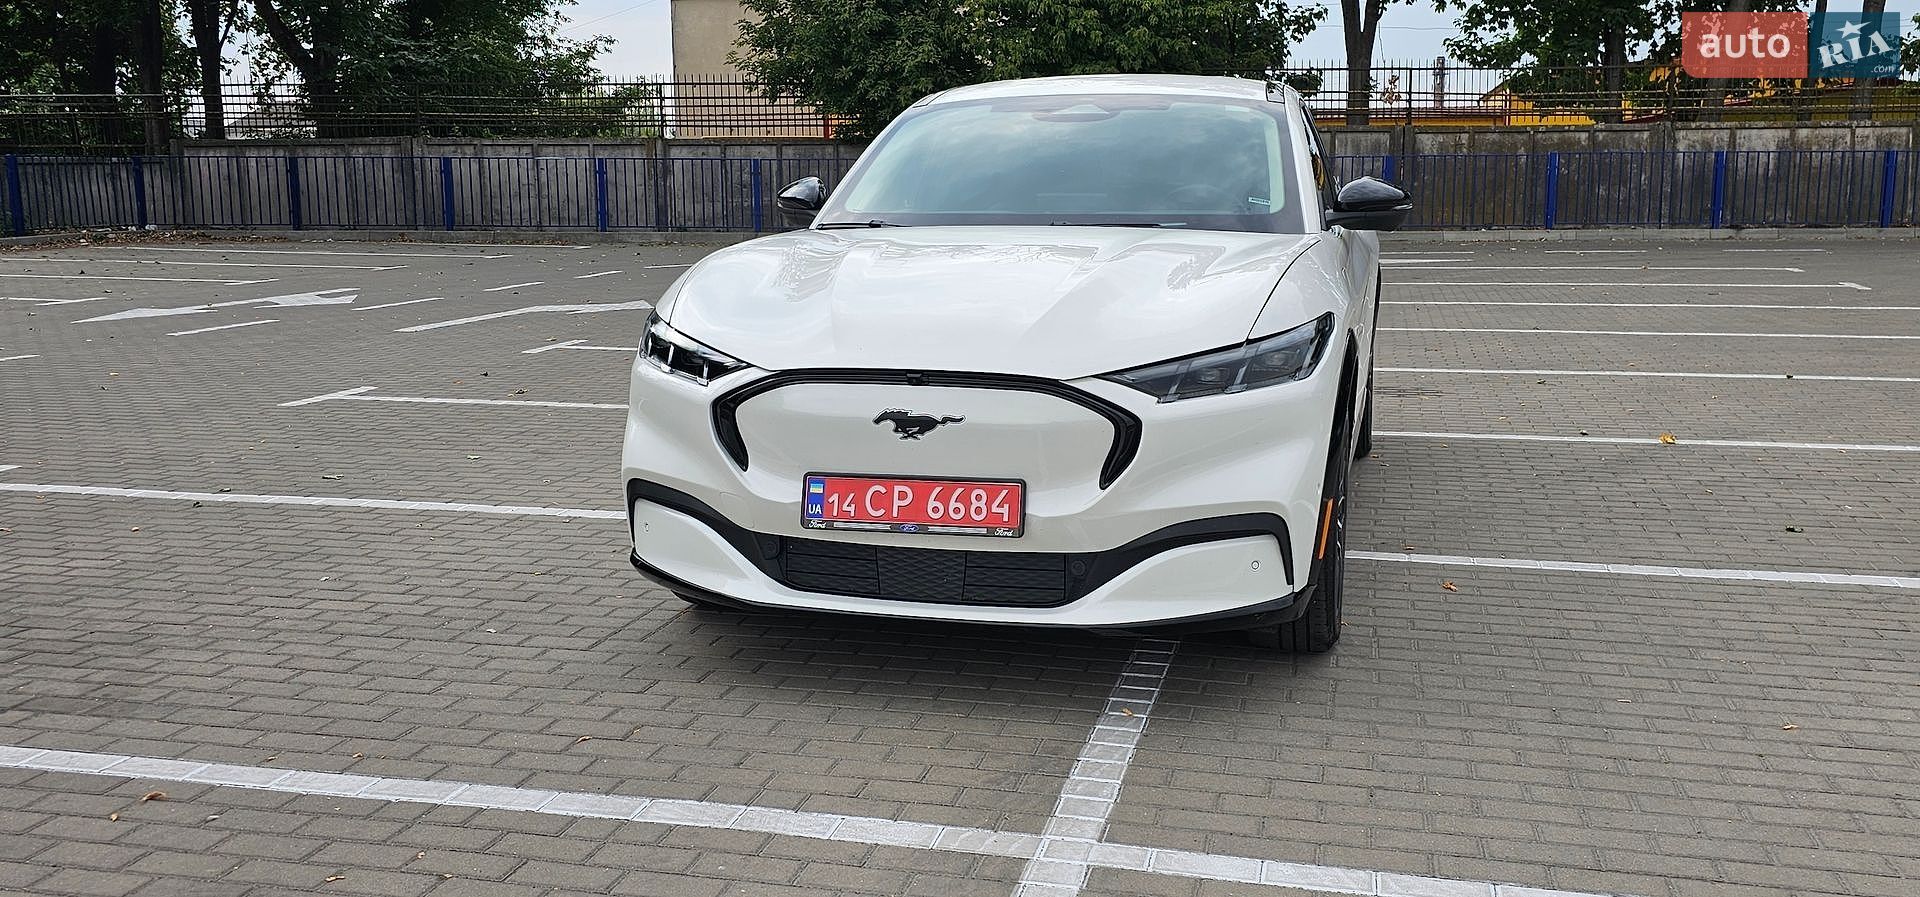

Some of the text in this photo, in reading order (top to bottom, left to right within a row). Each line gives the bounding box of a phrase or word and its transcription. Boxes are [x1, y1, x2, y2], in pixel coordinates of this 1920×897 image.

[828, 484, 1010, 522] 14 CP 6684
[808, 503, 822, 514] UA
[808, 520, 826, 528] Ford
[994, 527, 1014, 536] Ford
